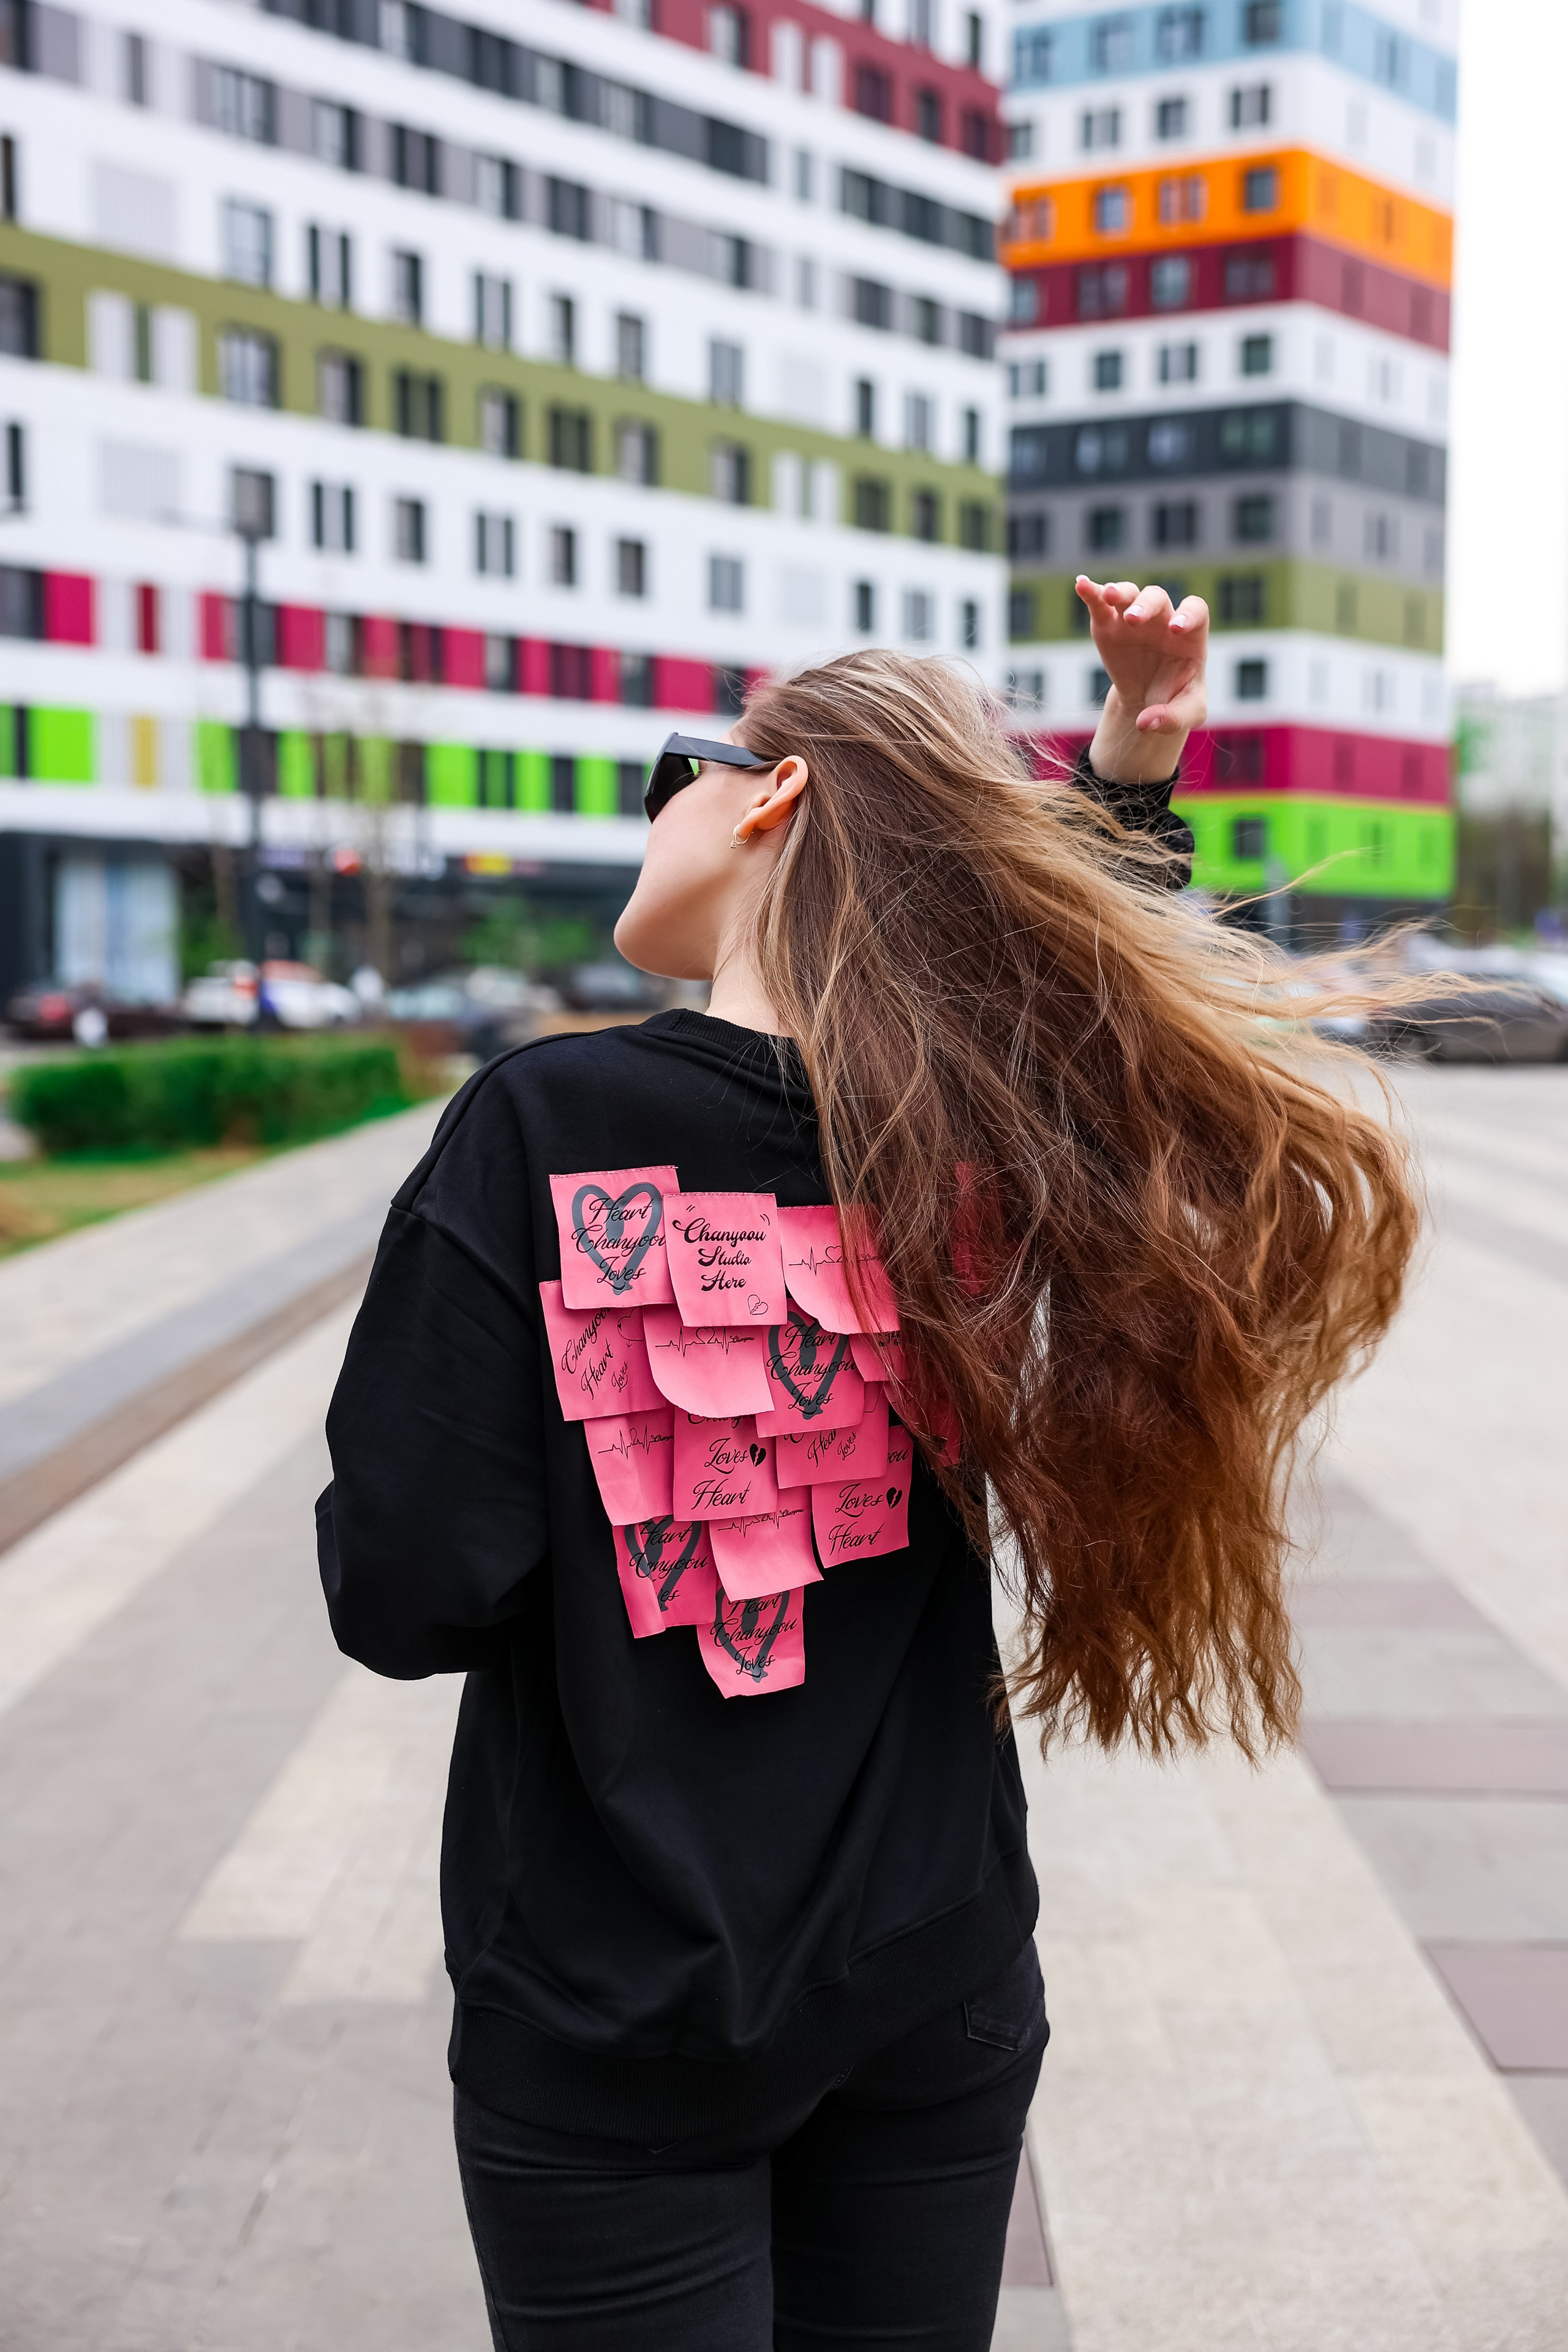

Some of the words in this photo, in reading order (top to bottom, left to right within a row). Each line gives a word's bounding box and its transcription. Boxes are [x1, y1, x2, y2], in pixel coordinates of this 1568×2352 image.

[589, 1196, 654, 1224] Heart
[698, 1245, 752, 1267] Studio
[597, 1256, 647, 1291] Loves
[700, 1269, 747, 1292] Here
[581, 1338, 614, 1401] Heart
[788, 1381, 834, 1415] Loves
[704, 1437, 749, 1474] Loves
[690, 1478, 752, 1510] Heart
[835, 1482, 884, 1518] Loves
[828, 1521, 885, 1556] Heart
[735, 1646, 776, 1675] Loves
